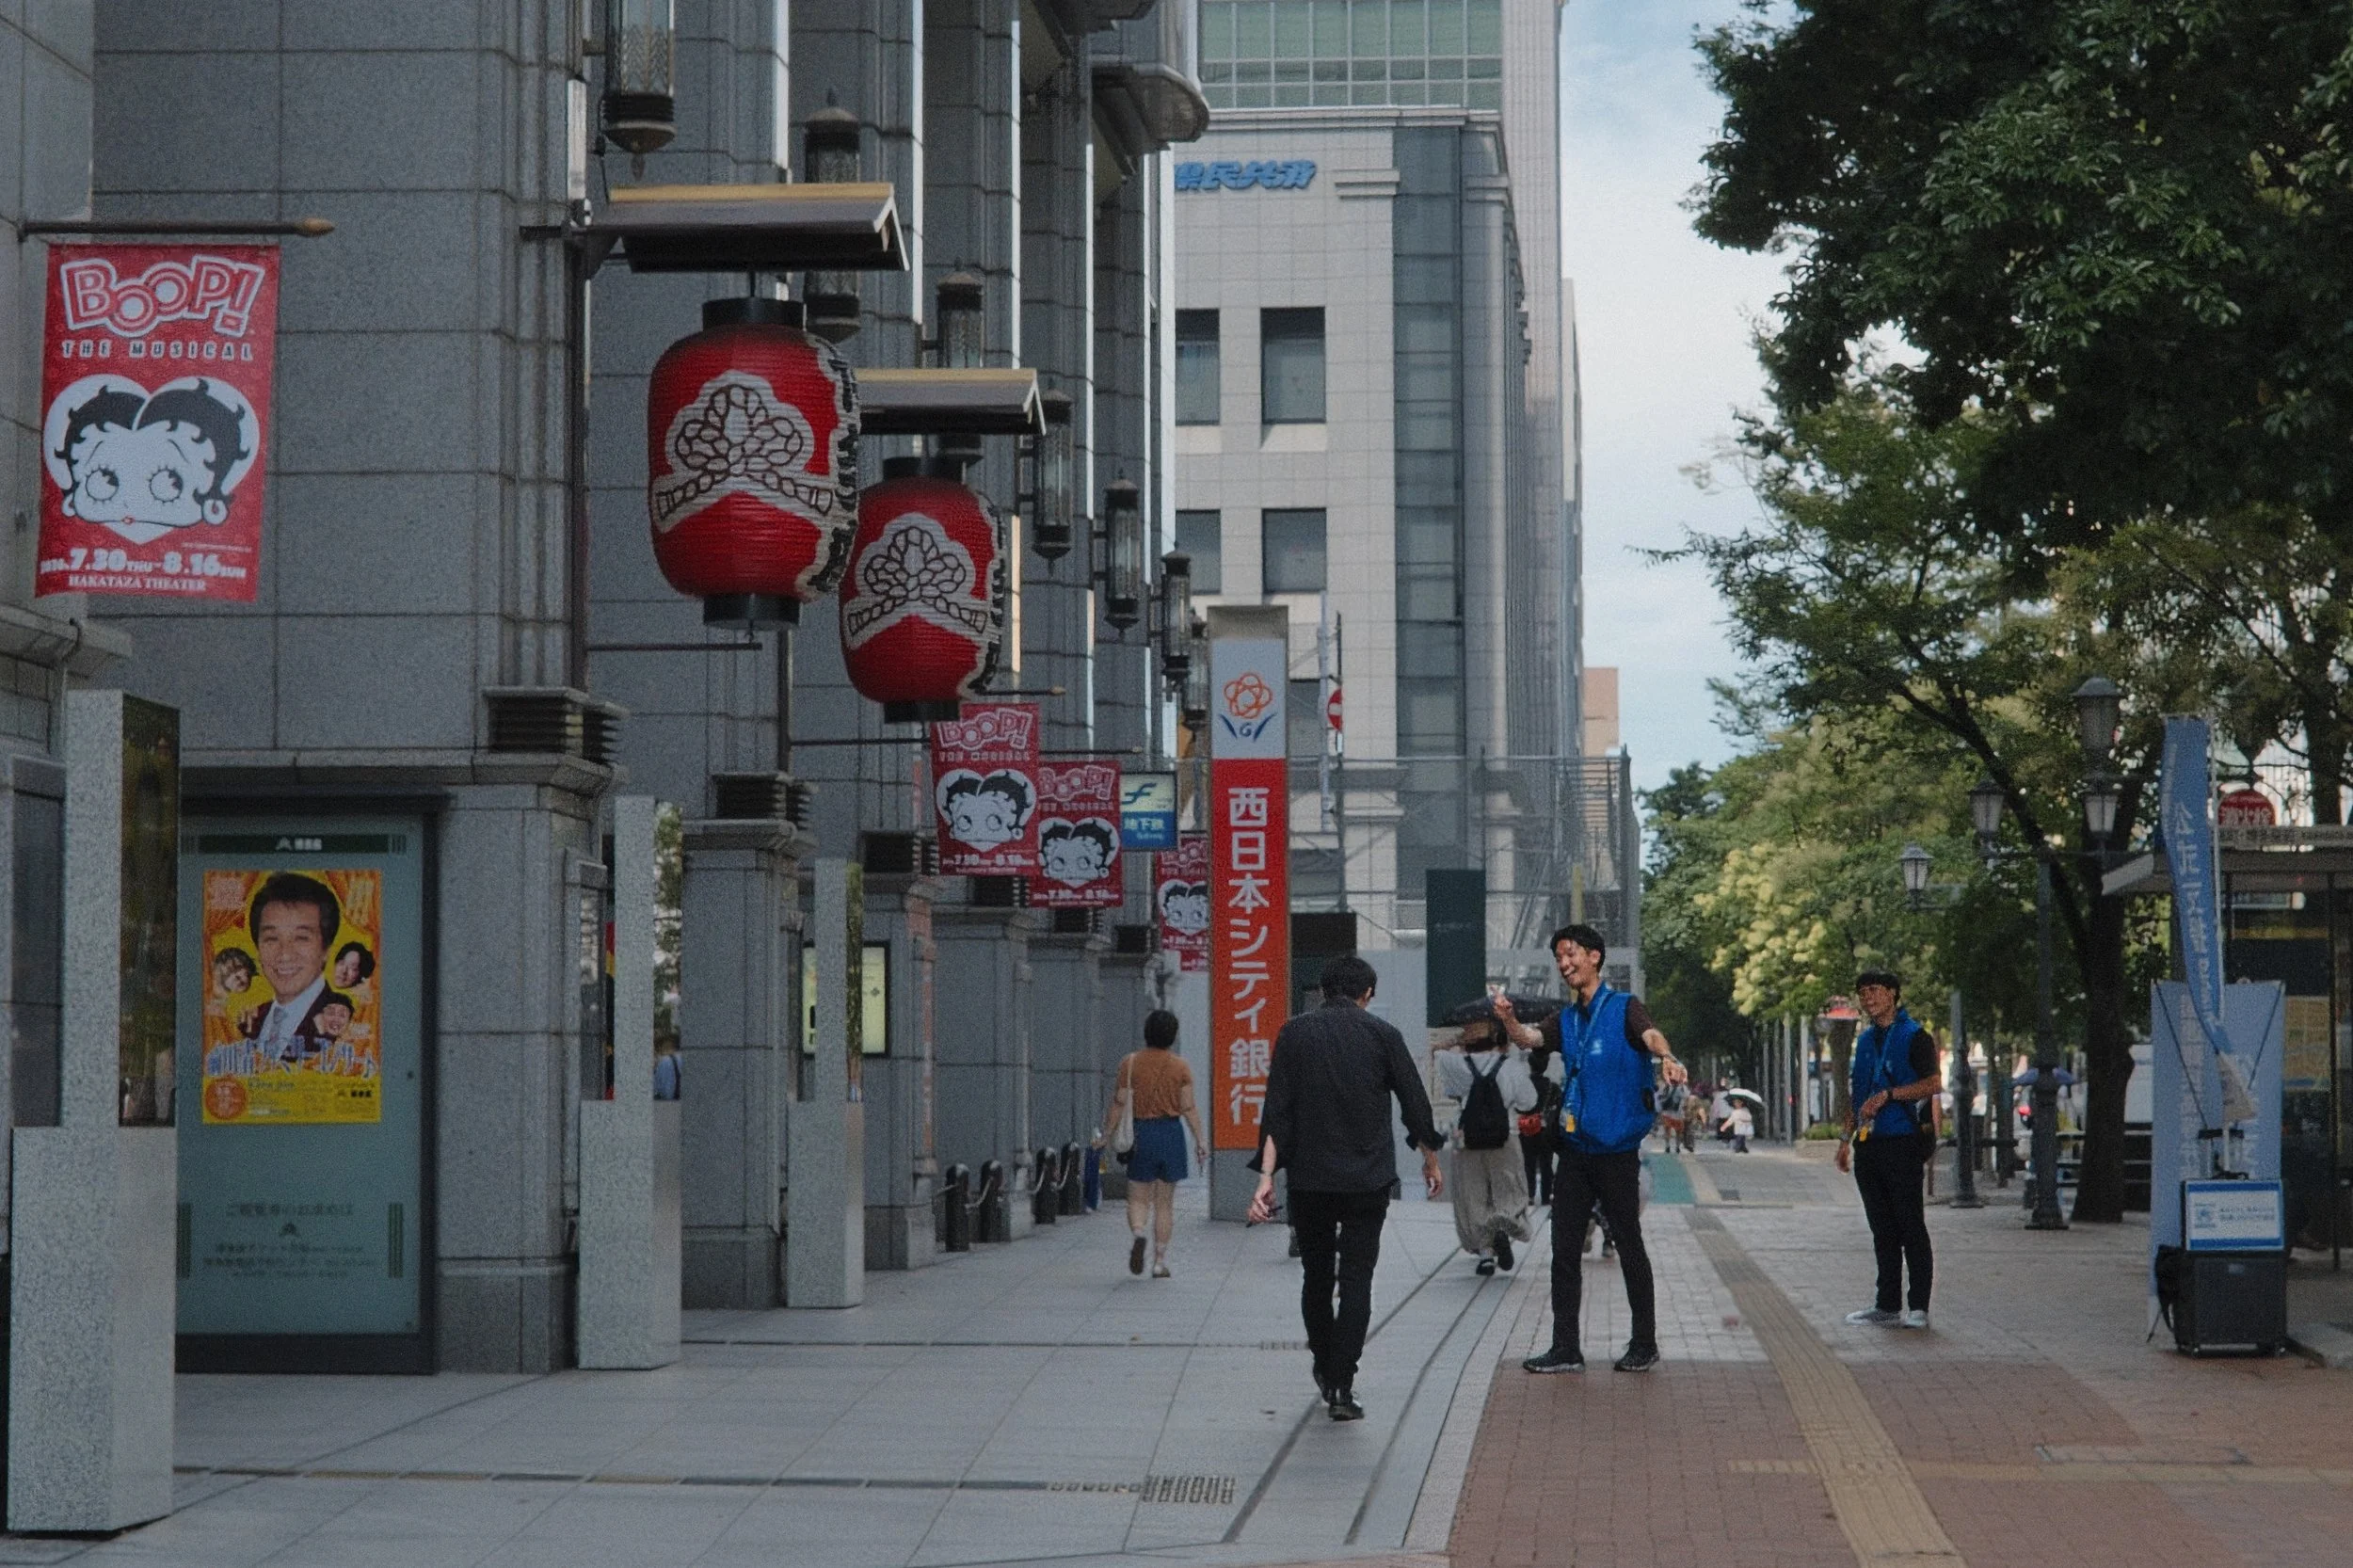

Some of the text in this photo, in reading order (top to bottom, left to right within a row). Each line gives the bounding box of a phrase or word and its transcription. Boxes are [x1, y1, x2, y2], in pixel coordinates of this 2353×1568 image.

[60, 255, 264, 338] BOOP!
[62, 339, 254, 361] THE MUSICAL
[145, 576, 207, 592] THEATER
[937, 708, 1032, 750] BOOP!
[1227, 787, 1271, 1126] 西日本シティ銀行
